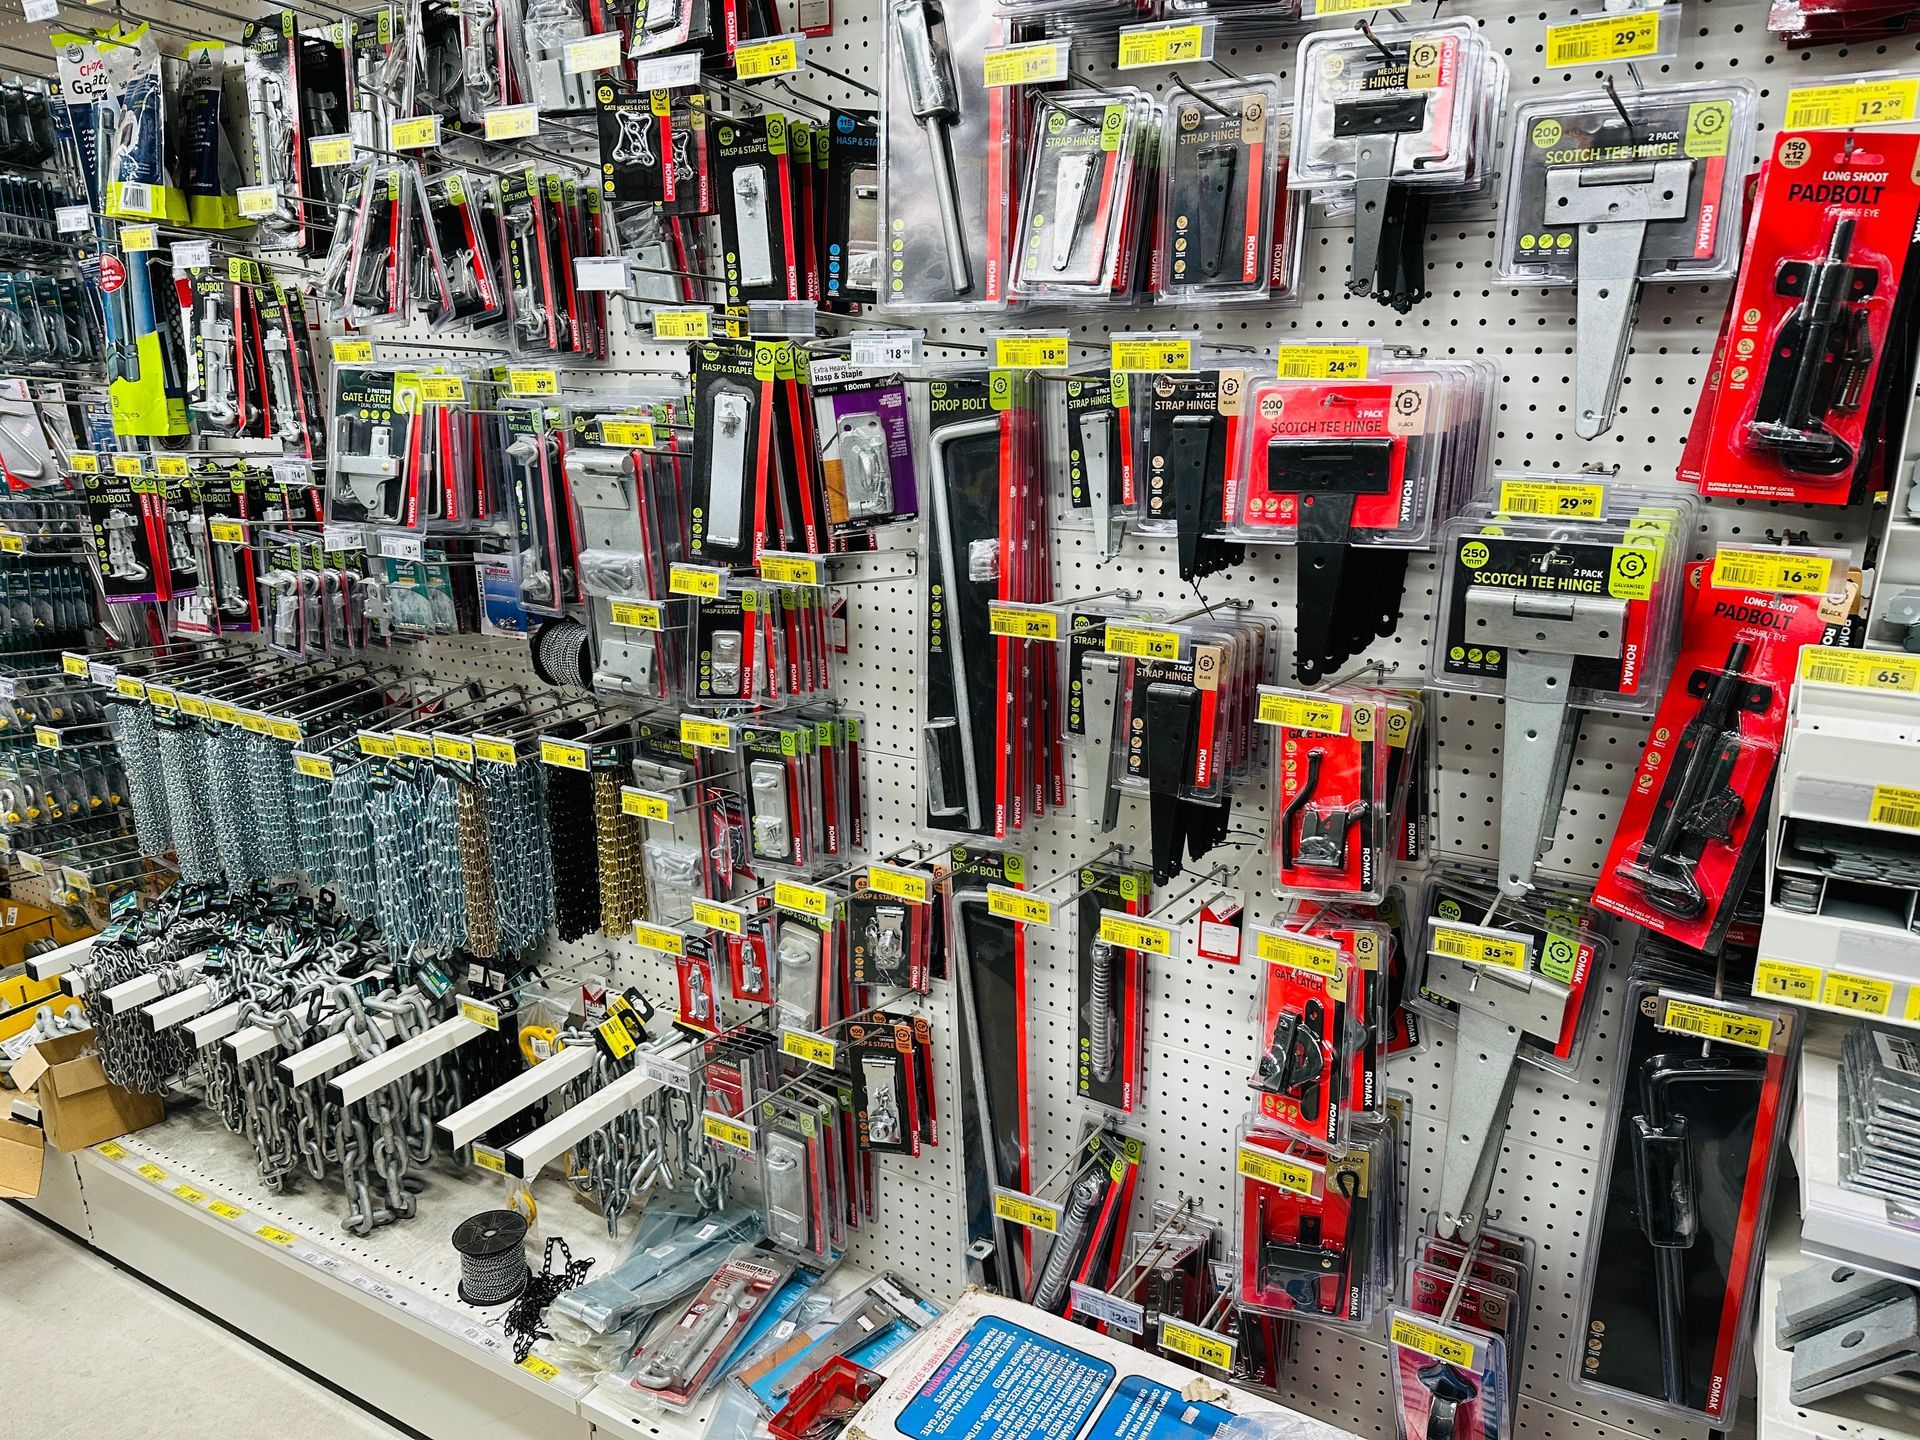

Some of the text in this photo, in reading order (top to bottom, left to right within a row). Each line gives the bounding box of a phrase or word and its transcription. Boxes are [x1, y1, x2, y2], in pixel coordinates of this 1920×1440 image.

[727, 11, 736, 52] ROMAK
[1615, 28, 1651, 46] 29.99
[1169, 41, 1192, 54] $7.99
[1441, 39, 1450, 85] ROMAK
[1377, 66, 1406, 75] MEDIUM
[600, 89, 611, 97] 50
[1860, 100, 1900, 114] 12.99
[1050, 118, 1065, 127] 100
[1183, 113, 1199, 122] 100
[1180, 129, 1240, 145] STRAP HINGE
[1534, 126, 1559, 138] 200
[1648, 131, 1679, 141] 2 PACK
[1046, 136, 1099, 147] STRAP HINGE
[1786, 142, 1806, 151] 150
[720, 148, 737, 156] HASP
[744, 144, 767, 154] STAPLE
[1546, 149, 1600, 164] SCOTCH
[665, 163, 673, 196] ROMAK
[1822, 171, 1889, 182] LONG SHOOT
[1789, 183, 1886, 205] PADBOLT
[1698, 204, 1713, 250] ROMAK
[1245, 235, 1255, 275] ROMAK
[788, 265, 796, 299] ROMAK
[987, 260, 996, 296] ROMAK
[197, 283, 223, 292] PADBOLT
[479, 279, 491, 306] ROMAK
[261, 309, 280, 317] PADBOLT
[571, 319, 580, 347] ROMAK
[886, 349, 910, 359] $18.99
[1042, 349, 1064, 359] 18.99
[1163, 351, 1184, 363] $8.99
[702, 363, 752, 375] HASP & STAPLE
[1329, 361, 1357, 373] 24.99
[815, 369, 863, 382] Hasp & Staple
[844, 381, 871, 391] 180mm
[342, 392, 391, 404] GATE LATCH
[1068, 396, 1111, 409] STRAP HINGE
[931, 398, 987, 412] DROP BOLT
[1155, 399, 1216, 411] STRAP HINGE
[1261, 400, 1282, 410] 200
[1363, 410, 1383, 418] PACK
[1271, 420, 1381, 434] SCOTCH TEE HINGE
[584, 431, 599, 441] GATE
[90, 494, 131, 503] PADBOLT
[1400, 480, 1413, 522] ROMAK
[1560, 497, 1593, 509] 29.99
[139, 495, 148, 517] ROMAK
[1462, 548, 1487, 559] 250
[1573, 568, 1604, 579] 2 PACK
[1783, 570, 1819, 583] 16.99
[1473, 571, 1602, 593] SCOTCH TEE HINGE
[1614, 582, 1645, 590] GALVANISED
[1743, 596, 1767, 608] LONG
[1713, 601, 1794, 631] PADBOLT
[1820, 607, 1842, 618] BLACK
[1149, 642, 1172, 653] 16.99
[1621, 644, 1637, 686] ROMAK
[1136, 667, 1192, 681] STRAP HINGE
[1306, 712, 1328, 722] $7.99
[1197, 748, 1207, 783] ROMAK
[1362, 847, 1370, 885] ROMAK
[1439, 903, 1460, 916] 300
[1140, 936, 1162, 946] 18.99
[1484, 946, 1514, 959] 35.99
[1573, 950, 1588, 984] ROMAK
[1772, 979, 1806, 991] $1.80
[1843, 989, 1879, 1003] $1.70
[1724, 1013, 1742, 1021] BLACK
[851, 1028, 863, 1036] 100
[1726, 1024, 1759, 1036] 17.29
[1364, 1071, 1373, 1107] ROMAK
[1328, 1103, 1337, 1139] ROMAK
[1344, 1156, 1365, 1164] BLACK
[1200, 1346, 1222, 1358] 14.99
[933, 1326, 997, 1406] FRAME KITS AND PRODUCTS
[991, 1340, 1030, 1389] POWDER COATED
[919, 1329, 1006, 1438] CHECK OUT OUR WIDE RANGE OF GATE
[934, 1333, 1015, 1435] GATE FRAME KITS TO SUIT ALL SIZES
[999, 1351, 1058, 1431] HEIGHT AND WIDTH CAN BE
[1011, 1355, 1067, 1431] SUITS RIGHT OR LEFT SIDE
[1024, 1359, 1077, 1431] HEAVY DUTY STEEL GATE
[1069, 1372, 1106, 1422] COMPLETE GATE
[1709, 1375, 1722, 1410] ROMAK
